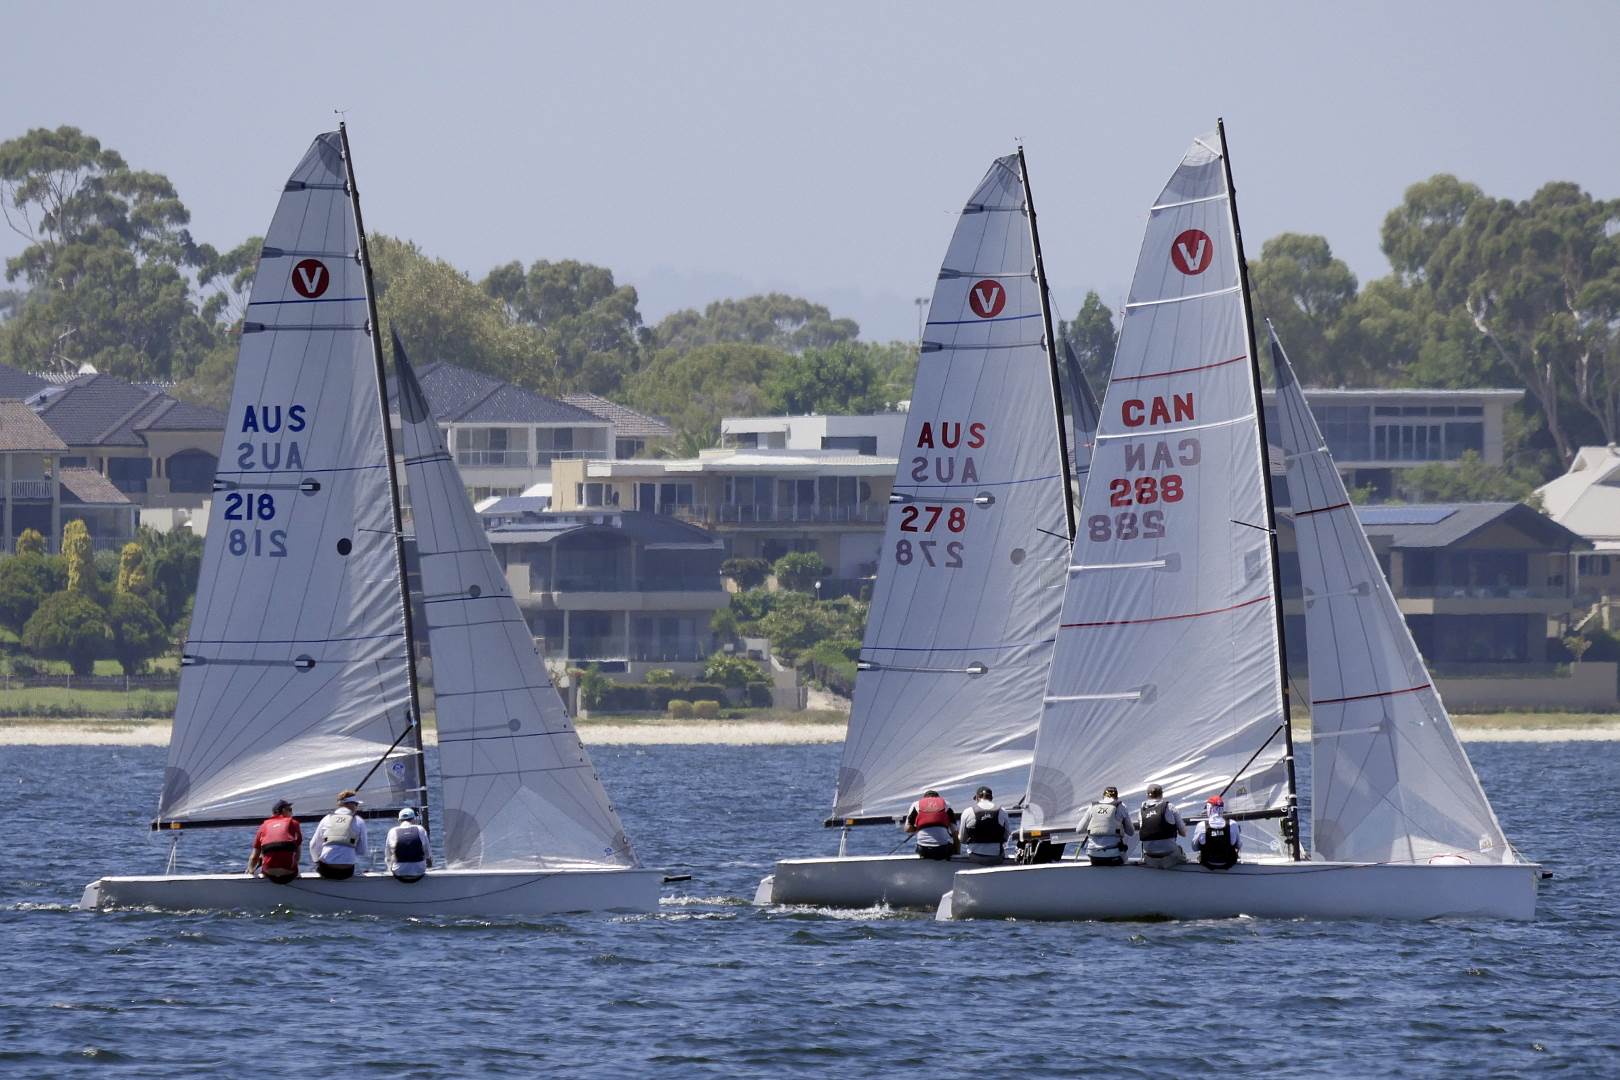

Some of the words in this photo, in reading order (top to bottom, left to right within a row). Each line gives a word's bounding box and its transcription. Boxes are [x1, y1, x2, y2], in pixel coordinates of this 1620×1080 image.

[1177, 240, 1206, 271] V
[297, 267, 323, 293] V
[975, 287, 999, 313] V
[241, 405, 306, 433] AUS
[1121, 392, 1195, 427] CAN
[917, 422, 986, 449] AUS
[1109, 474, 1184, 507] 288
[224, 493, 276, 521] 218
[900, 505, 966, 532] 278
